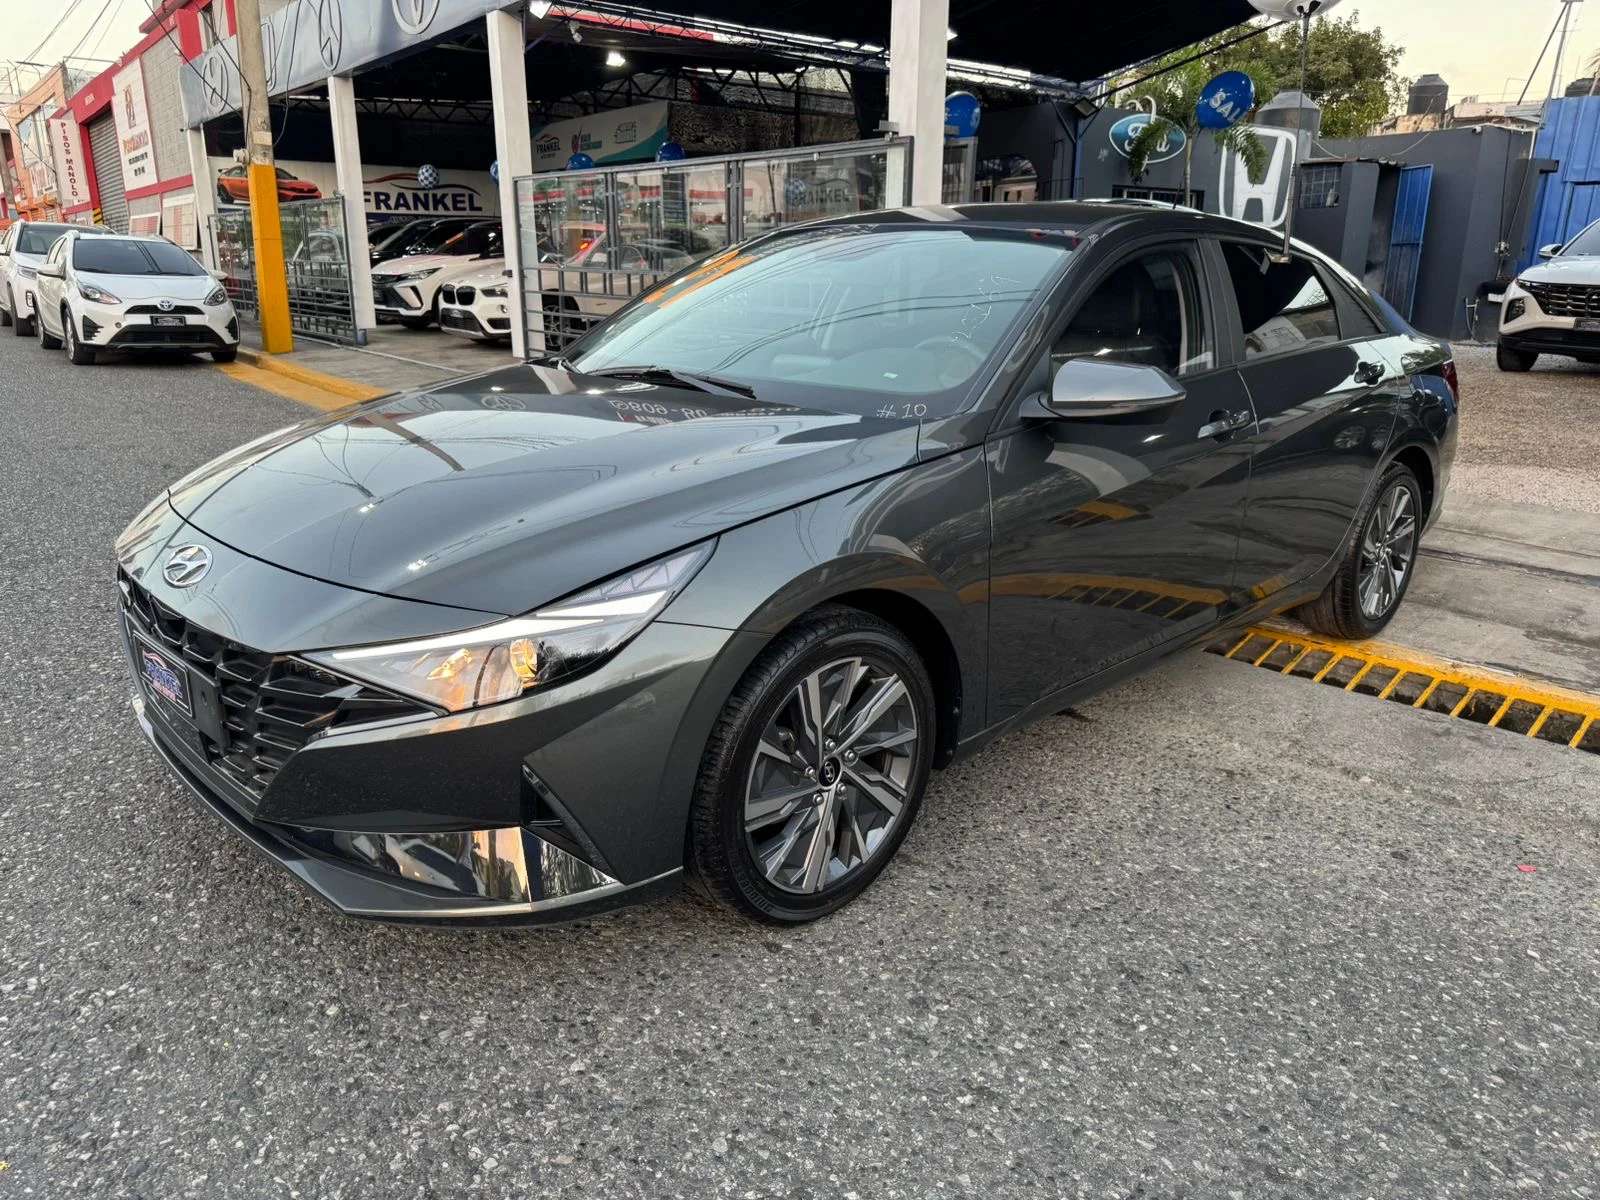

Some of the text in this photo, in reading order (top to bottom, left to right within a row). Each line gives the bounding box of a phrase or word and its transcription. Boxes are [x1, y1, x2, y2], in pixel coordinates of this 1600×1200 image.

[60, 121, 78, 197] PISOS MANOLO
[363, 191, 483, 211] FRANKEL
